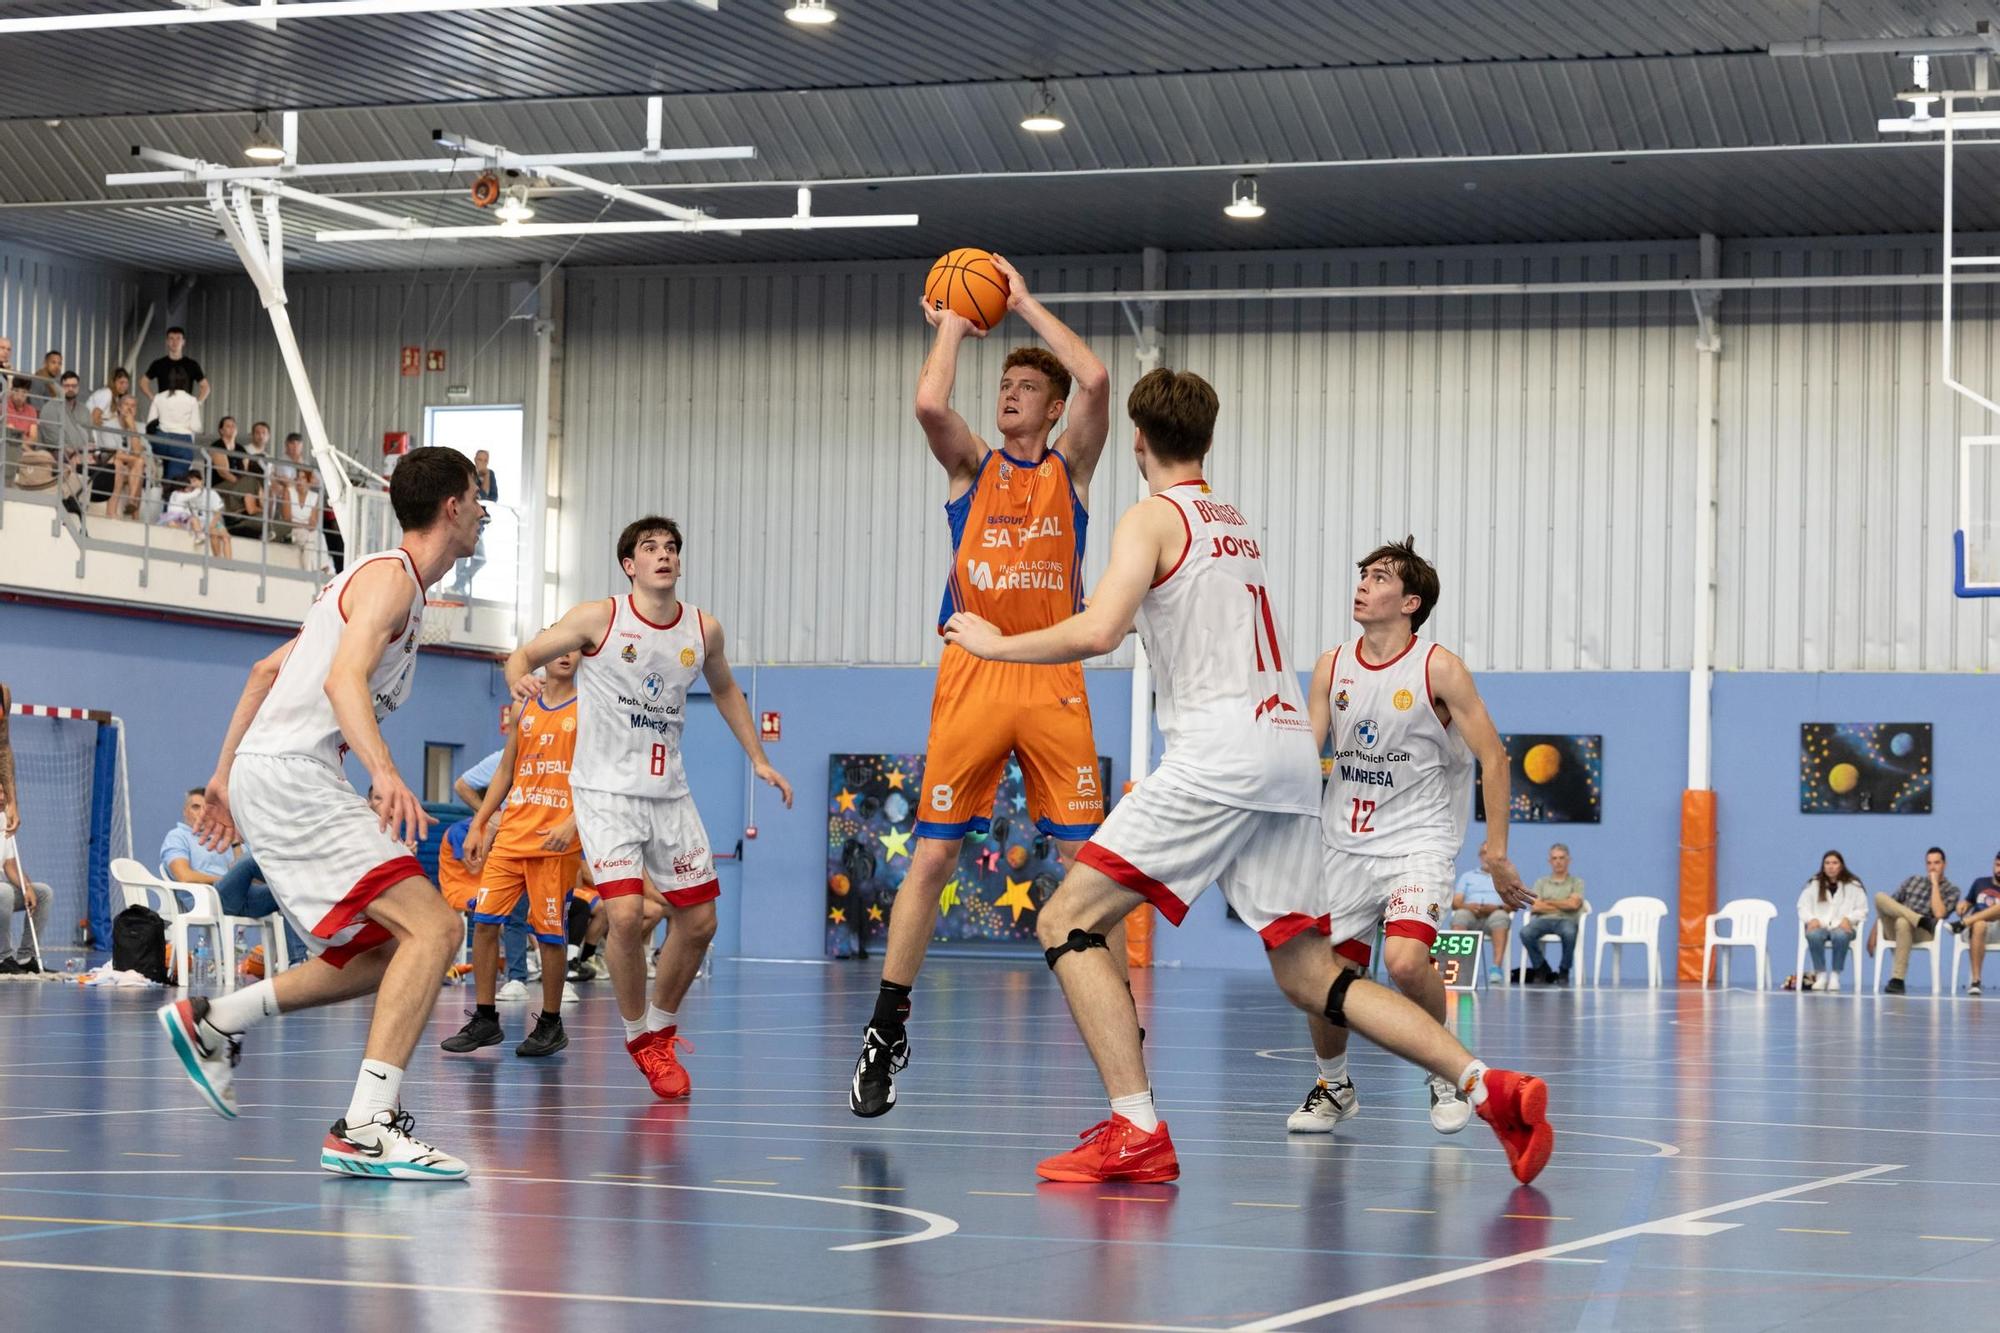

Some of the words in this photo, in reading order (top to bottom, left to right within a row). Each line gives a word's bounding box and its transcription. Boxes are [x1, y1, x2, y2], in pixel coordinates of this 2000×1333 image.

[982, 528, 1012, 548] SA
[1018, 516, 1062, 547] REAL
[1211, 535, 1261, 559] JOYSA
[1245, 583, 1282, 672] 11
[618, 695, 641, 706] Mot
[540, 733, 555, 746] 97
[519, 762, 533, 777] SA
[537, 759, 571, 775] REAL
[650, 743, 666, 776] 8
[1341, 765, 1395, 788] MANRESA
[523, 793, 569, 809] REVALO
[931, 784, 953, 812] 8
[1351, 798, 1376, 833] 12
[674, 862, 697, 875] ETL
[677, 866, 712, 882] GLOBAL
[1390, 905, 1421, 916] OBAL
